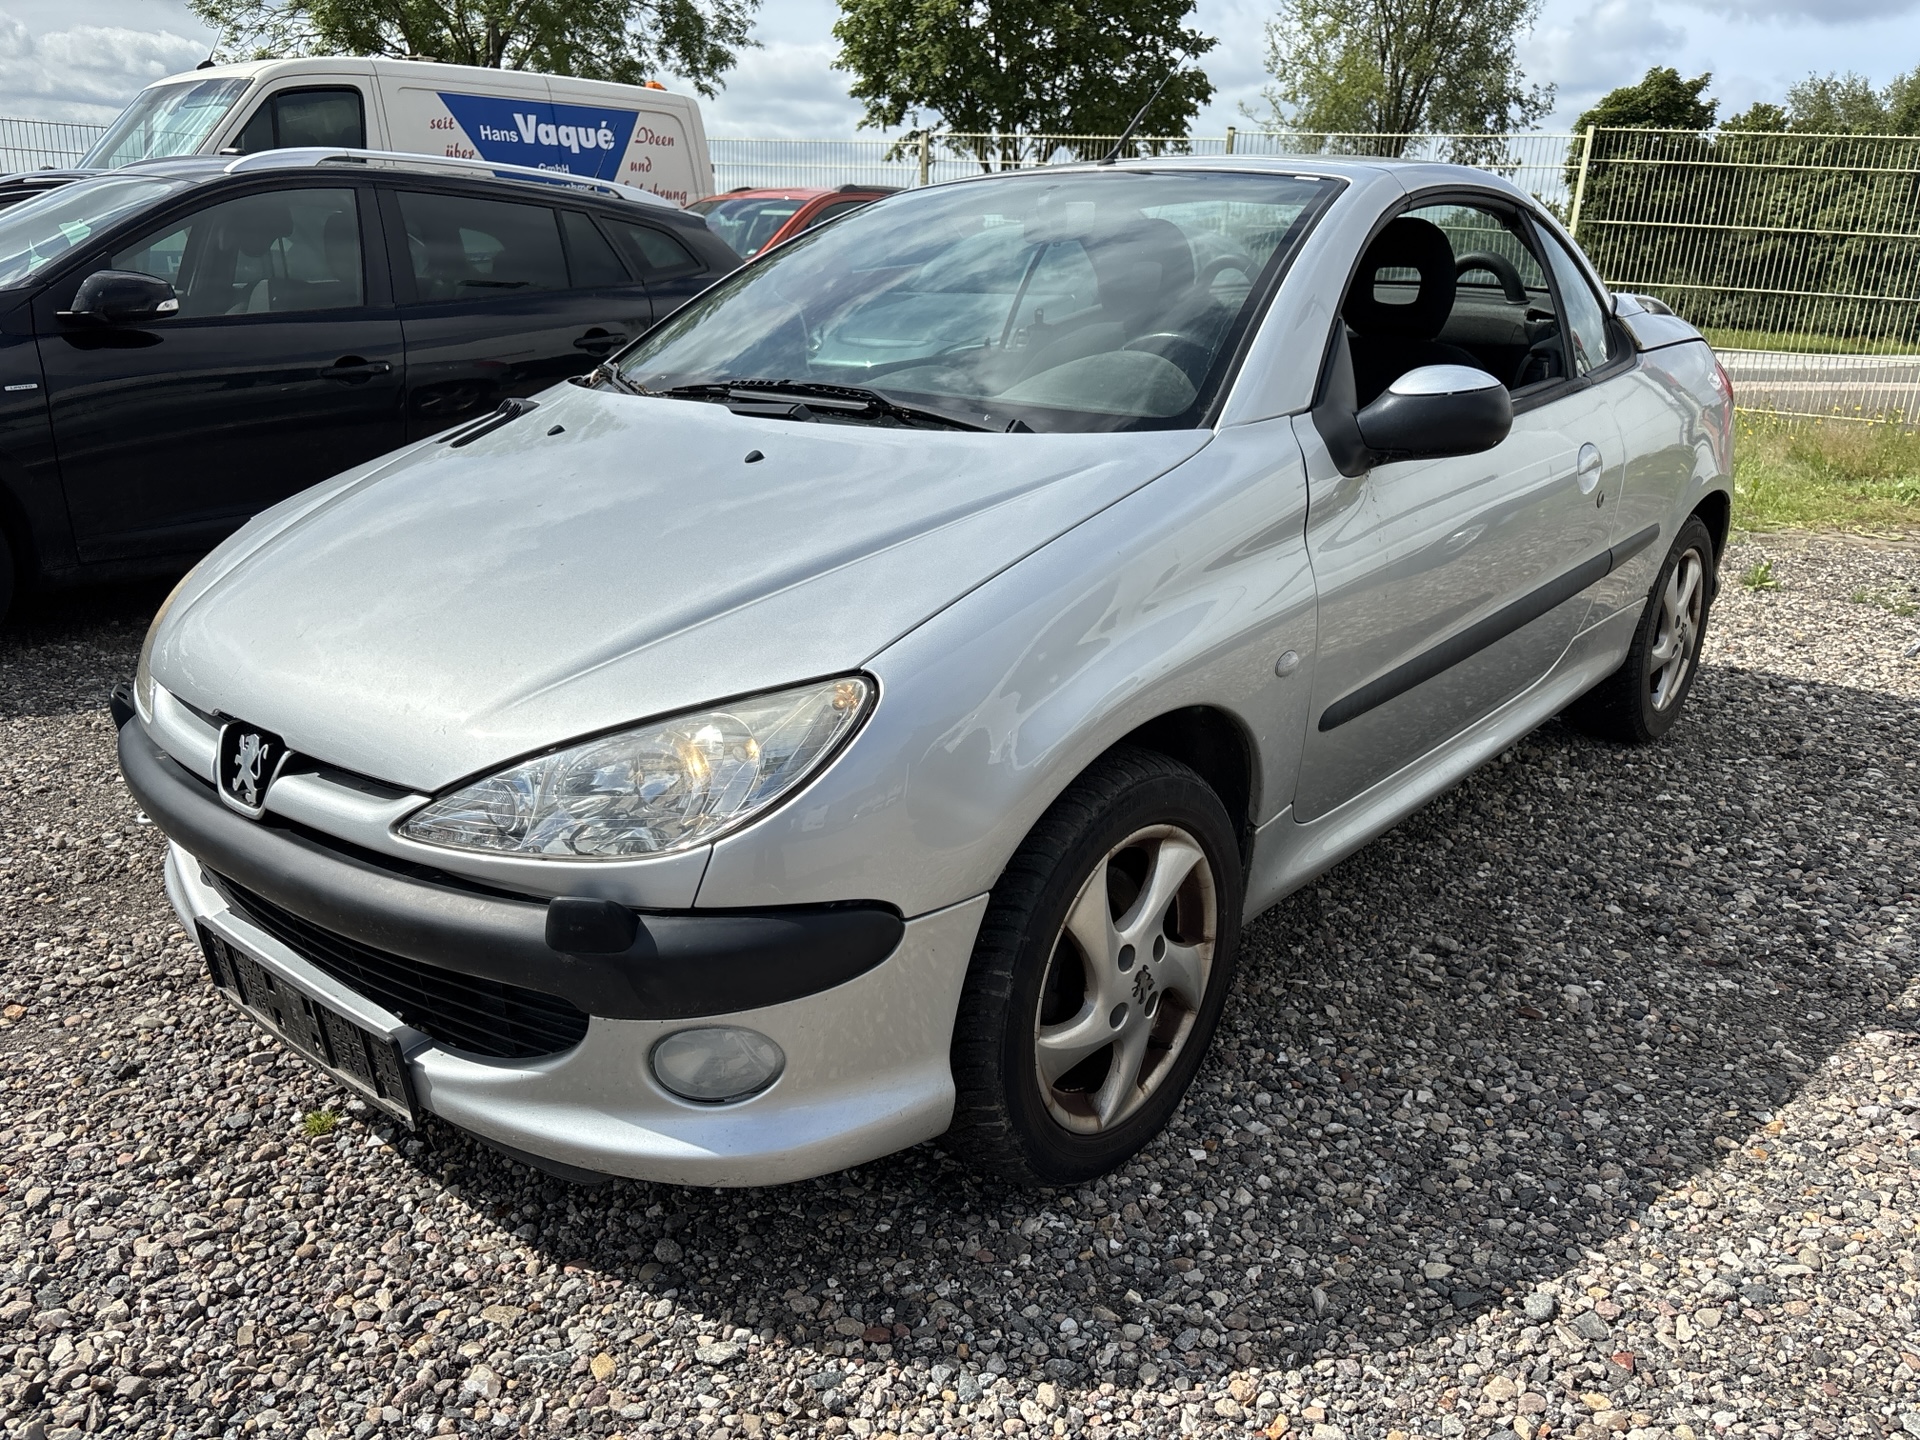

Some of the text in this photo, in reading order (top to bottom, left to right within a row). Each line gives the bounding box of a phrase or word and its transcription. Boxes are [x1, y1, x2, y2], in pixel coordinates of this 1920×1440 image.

[430, 116, 455, 130] seit
[479, 112, 616, 154] Hans Vaqué
[634, 126, 675, 147] Ideen
[445, 142, 475, 160] über
[629, 156, 652, 173] und
